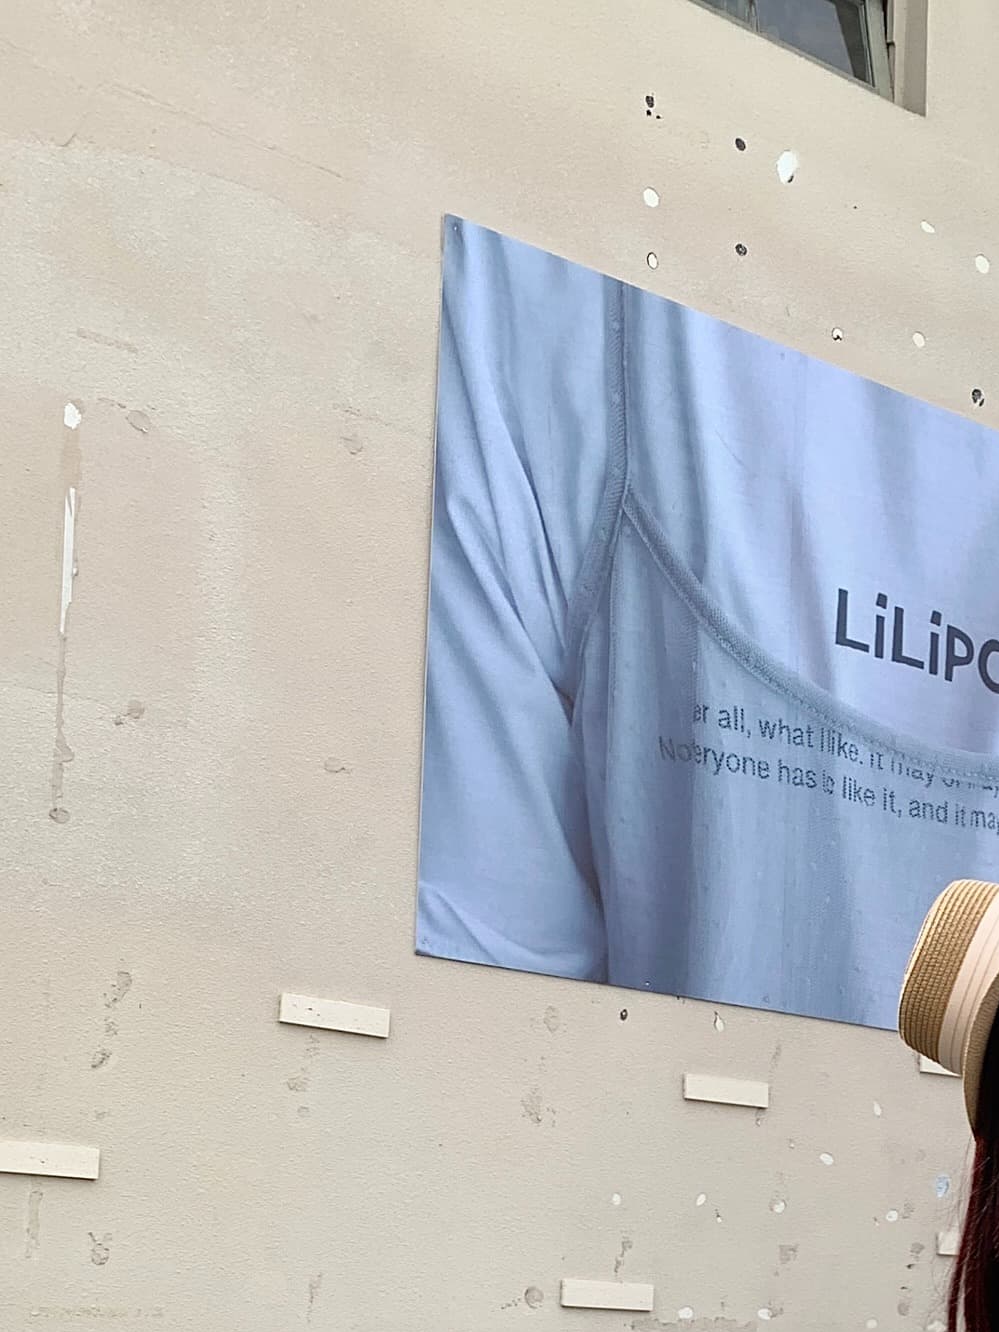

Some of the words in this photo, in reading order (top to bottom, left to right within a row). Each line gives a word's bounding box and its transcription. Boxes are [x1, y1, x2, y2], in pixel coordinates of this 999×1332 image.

[718, 706, 751, 738] all,
[758, 718, 814, 748] what
[778, 759, 817, 788] has
[842, 776, 876, 807] like
[883, 787, 902, 818] it,
[909, 799, 949, 824] and
